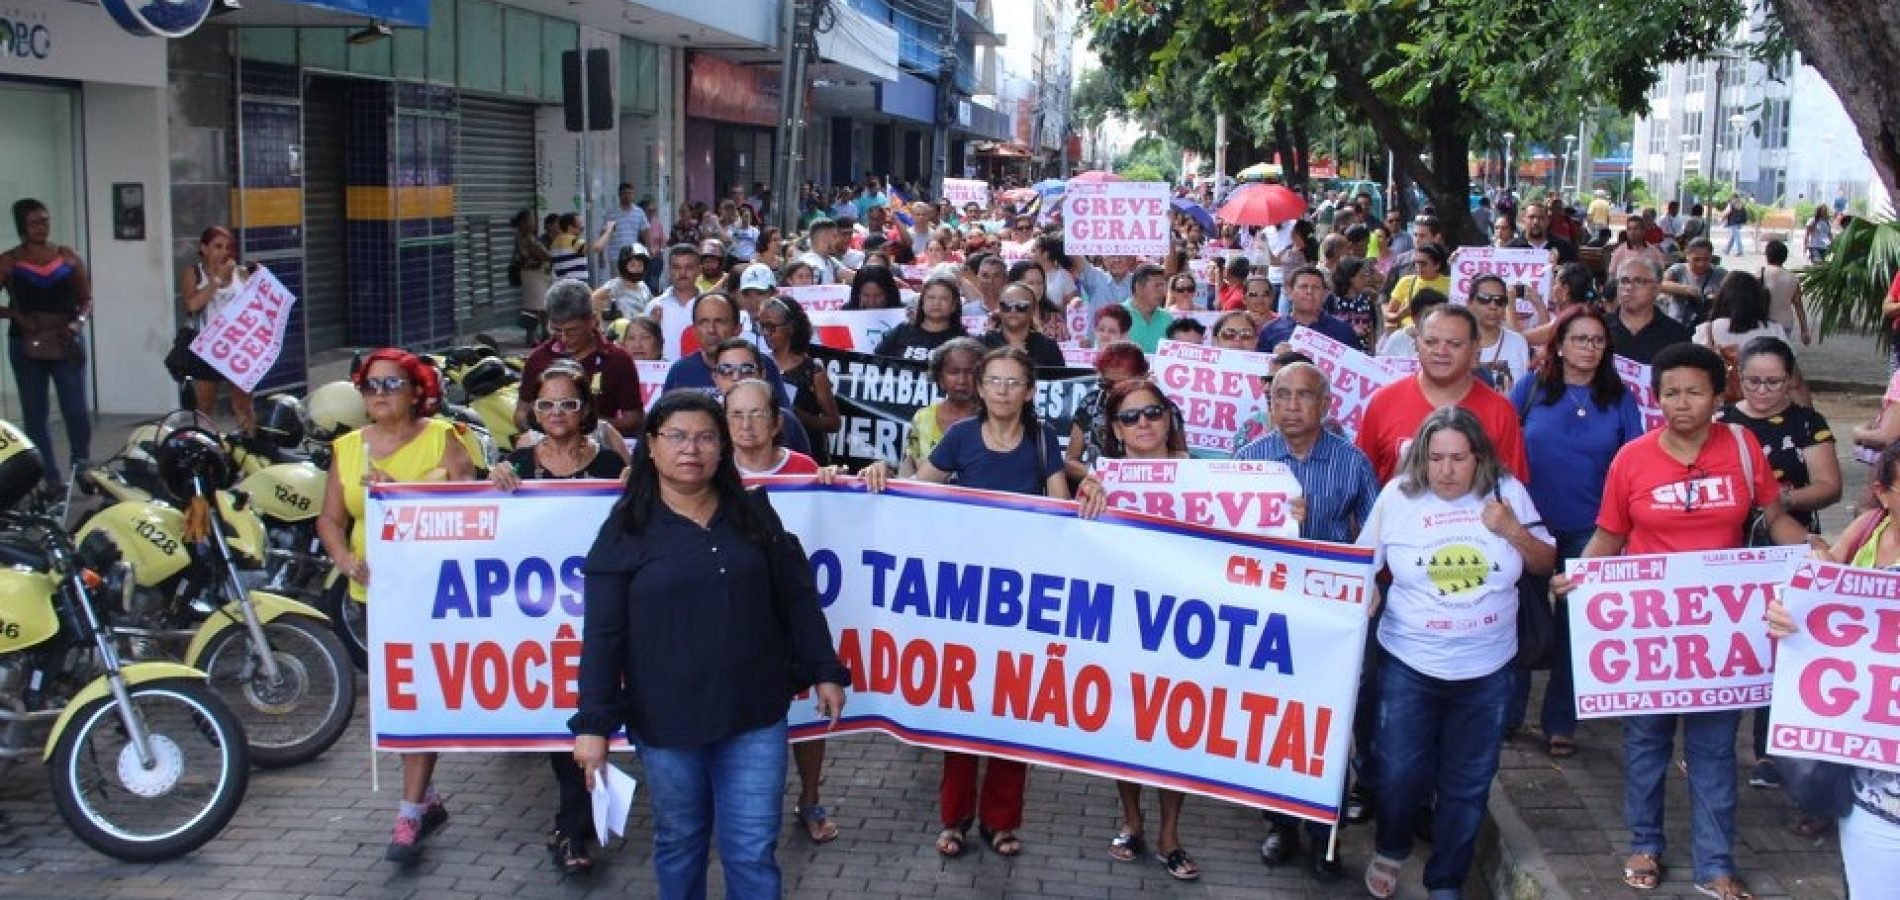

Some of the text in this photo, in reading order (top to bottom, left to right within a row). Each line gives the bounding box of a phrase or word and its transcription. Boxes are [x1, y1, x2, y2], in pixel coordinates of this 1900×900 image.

[1072, 198, 1163, 216] GREVE
[1071, 219, 1163, 240] GERAL
[1458, 261, 1545, 278] GREVE
[212, 279, 273, 359] GREVE
[229, 293, 283, 374] GERAL
[1164, 364, 1264, 400] GREV
[275, 485, 310, 511] 1248
[136, 519, 178, 556] 1028
[420, 511, 495, 538] SINTE-PI
[1604, 559, 1665, 580] SINTE-PI
[861, 550, 1115, 643] TAMBEM
[1134, 590, 1294, 675] VOTA
[384, 642, 417, 711] E
[430, 624, 583, 711] VOCÊ
[991, 642, 1112, 733] NÃO
[1130, 672, 1332, 778] VOLTA!
[1581, 692, 1653, 713] CULPA
[1662, 690, 1693, 707] DO
[1776, 727, 1885, 761] CULPA
